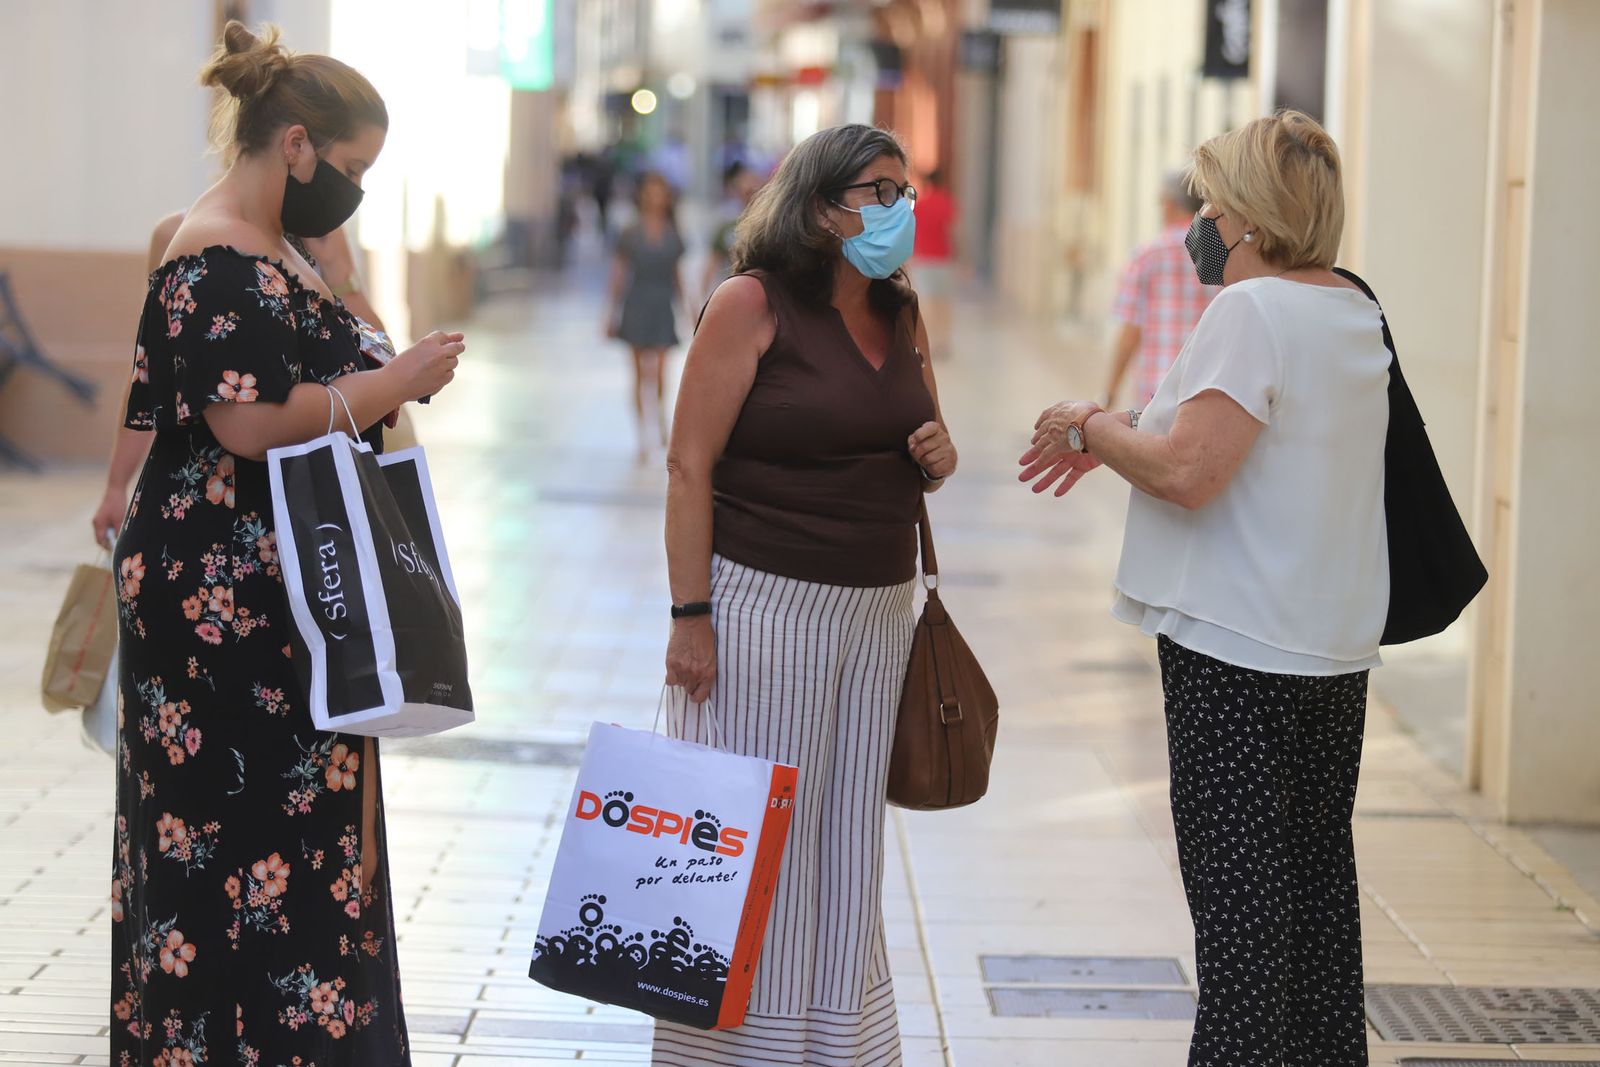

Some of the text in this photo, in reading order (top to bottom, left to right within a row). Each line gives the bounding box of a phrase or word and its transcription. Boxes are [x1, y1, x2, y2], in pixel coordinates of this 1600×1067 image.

[655, 856, 724, 870] Un paso
[635, 871, 739, 890] por delante!
[636, 980, 710, 1007] www.dospies.es
